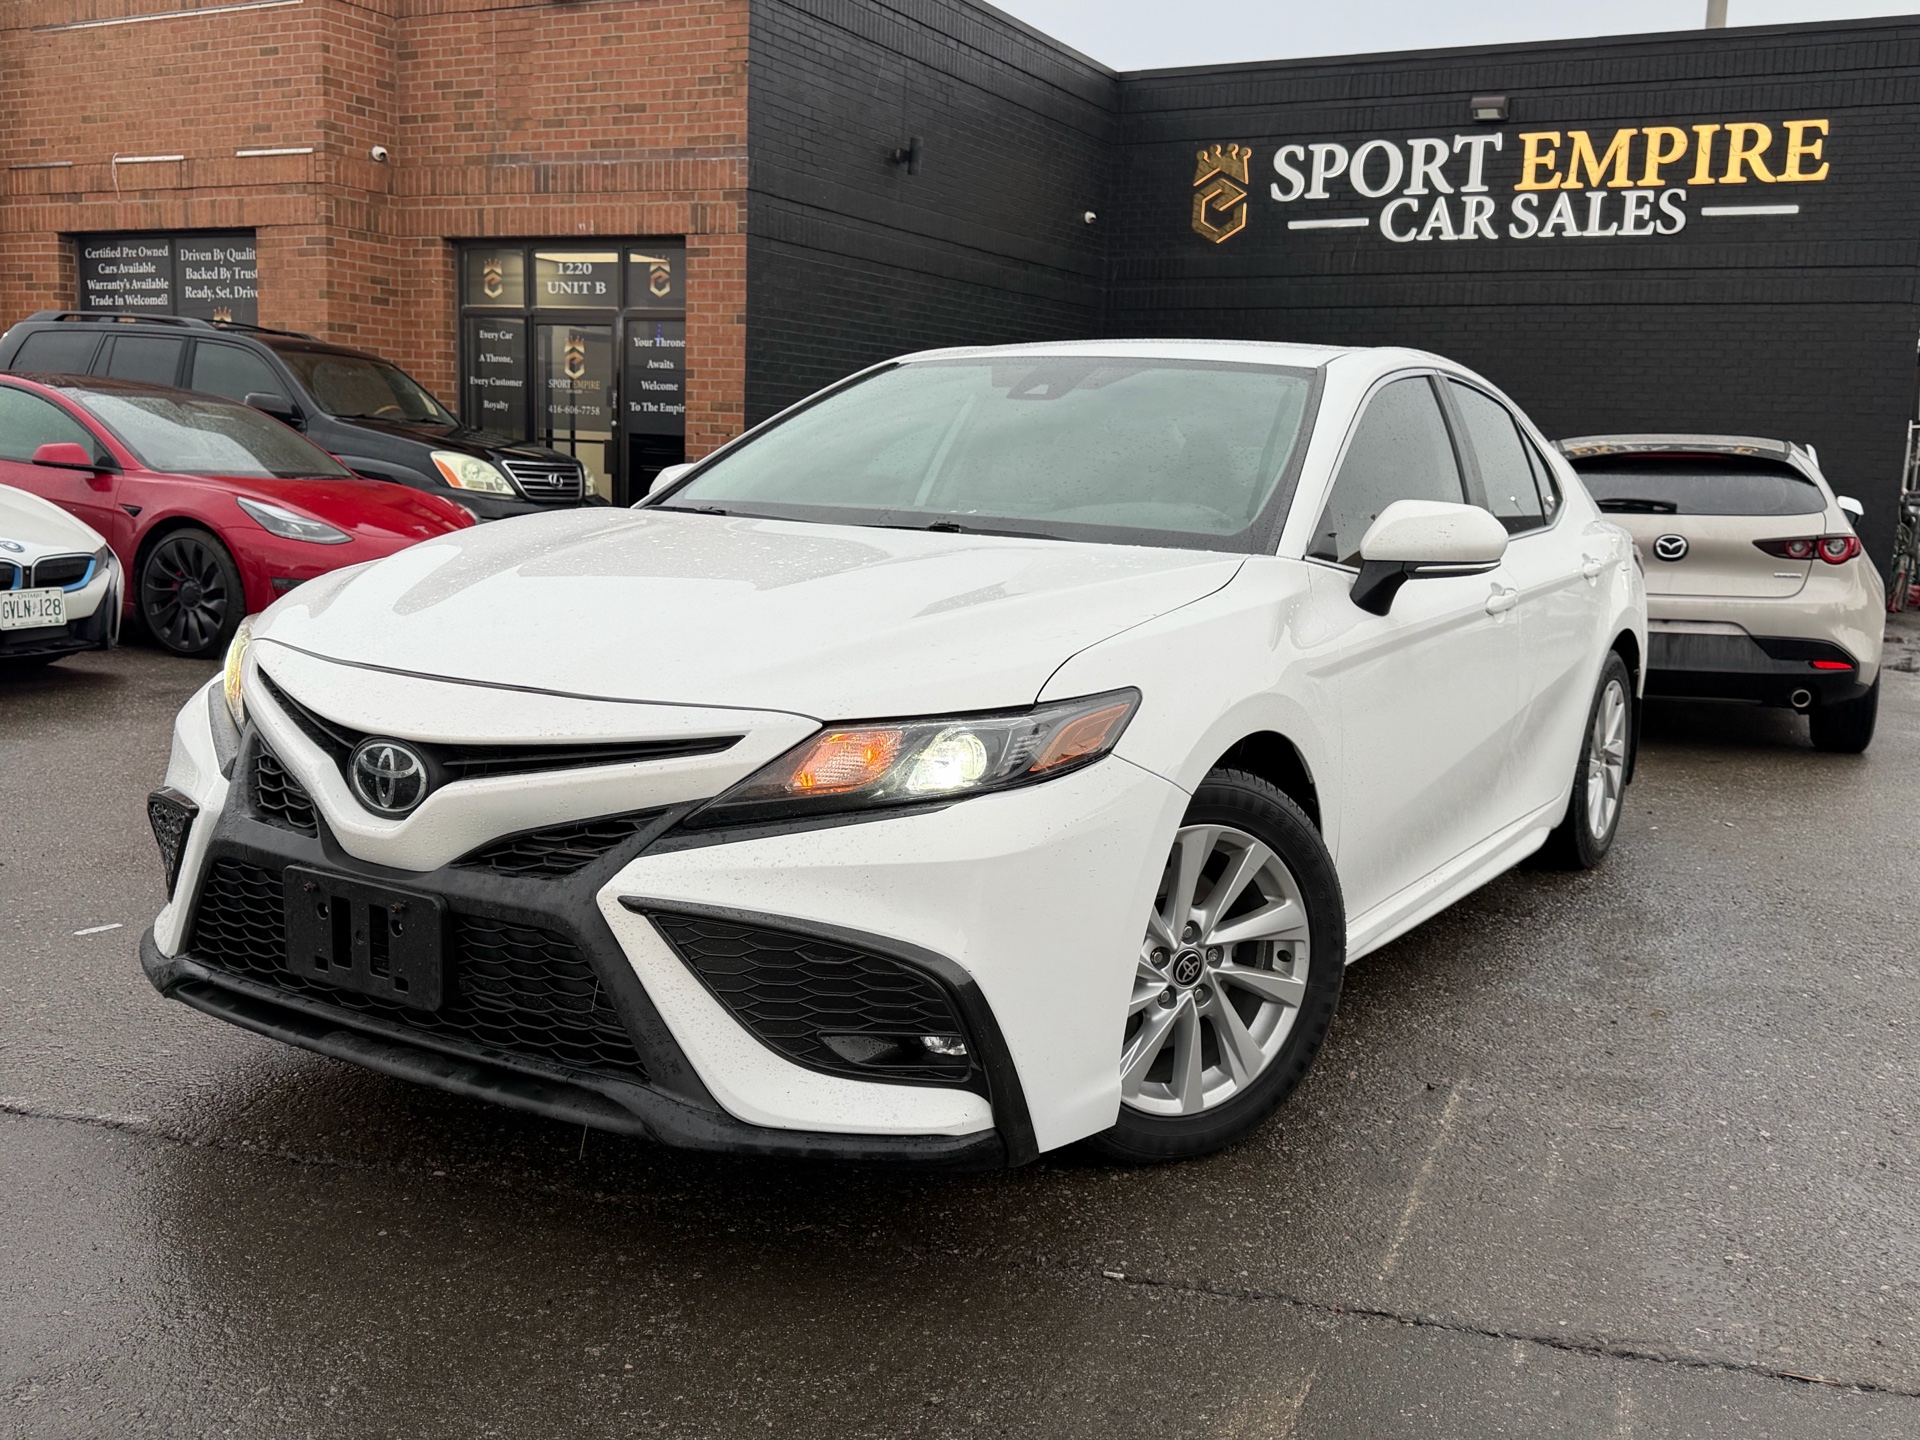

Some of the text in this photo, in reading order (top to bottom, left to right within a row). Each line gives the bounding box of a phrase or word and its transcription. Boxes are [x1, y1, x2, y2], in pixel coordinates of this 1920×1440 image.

[1270, 119, 1830, 202] SPORT EMPIRE
[1380, 188, 1686, 242] CAR SALES
[85, 245, 168, 258] Certified Pre Owned
[180, 249, 212, 261] Driven
[213, 248, 225, 264] By
[98, 262, 156, 274] Cars Available
[557, 262, 592, 275] 1220
[186, 266, 218, 280] Backed
[220, 267, 232, 283] By
[86, 278, 169, 292] Warranty's Available
[546, 281, 607, 294] UNIT B
[185, 285, 214, 302] Ready,
[216, 286, 233, 299] Set,
[90, 294, 113, 306] Trade
[114, 295, 124, 306] In
[479, 330, 513, 341] Every Car
[633, 337, 686, 348] Your Throne
[479, 354, 485, 362] A
[647, 359, 674, 369] Awaits
[470, 376, 523, 387] Every Customer
[548, 379, 600, 390] SPORT EMPIRE
[641, 381, 678, 391] Welcome
[483, 400, 509, 412] Royalty
[629, 401, 641, 412] To
[641, 402, 658, 412] The
[3, 598, 61, 619] GVLN 128
